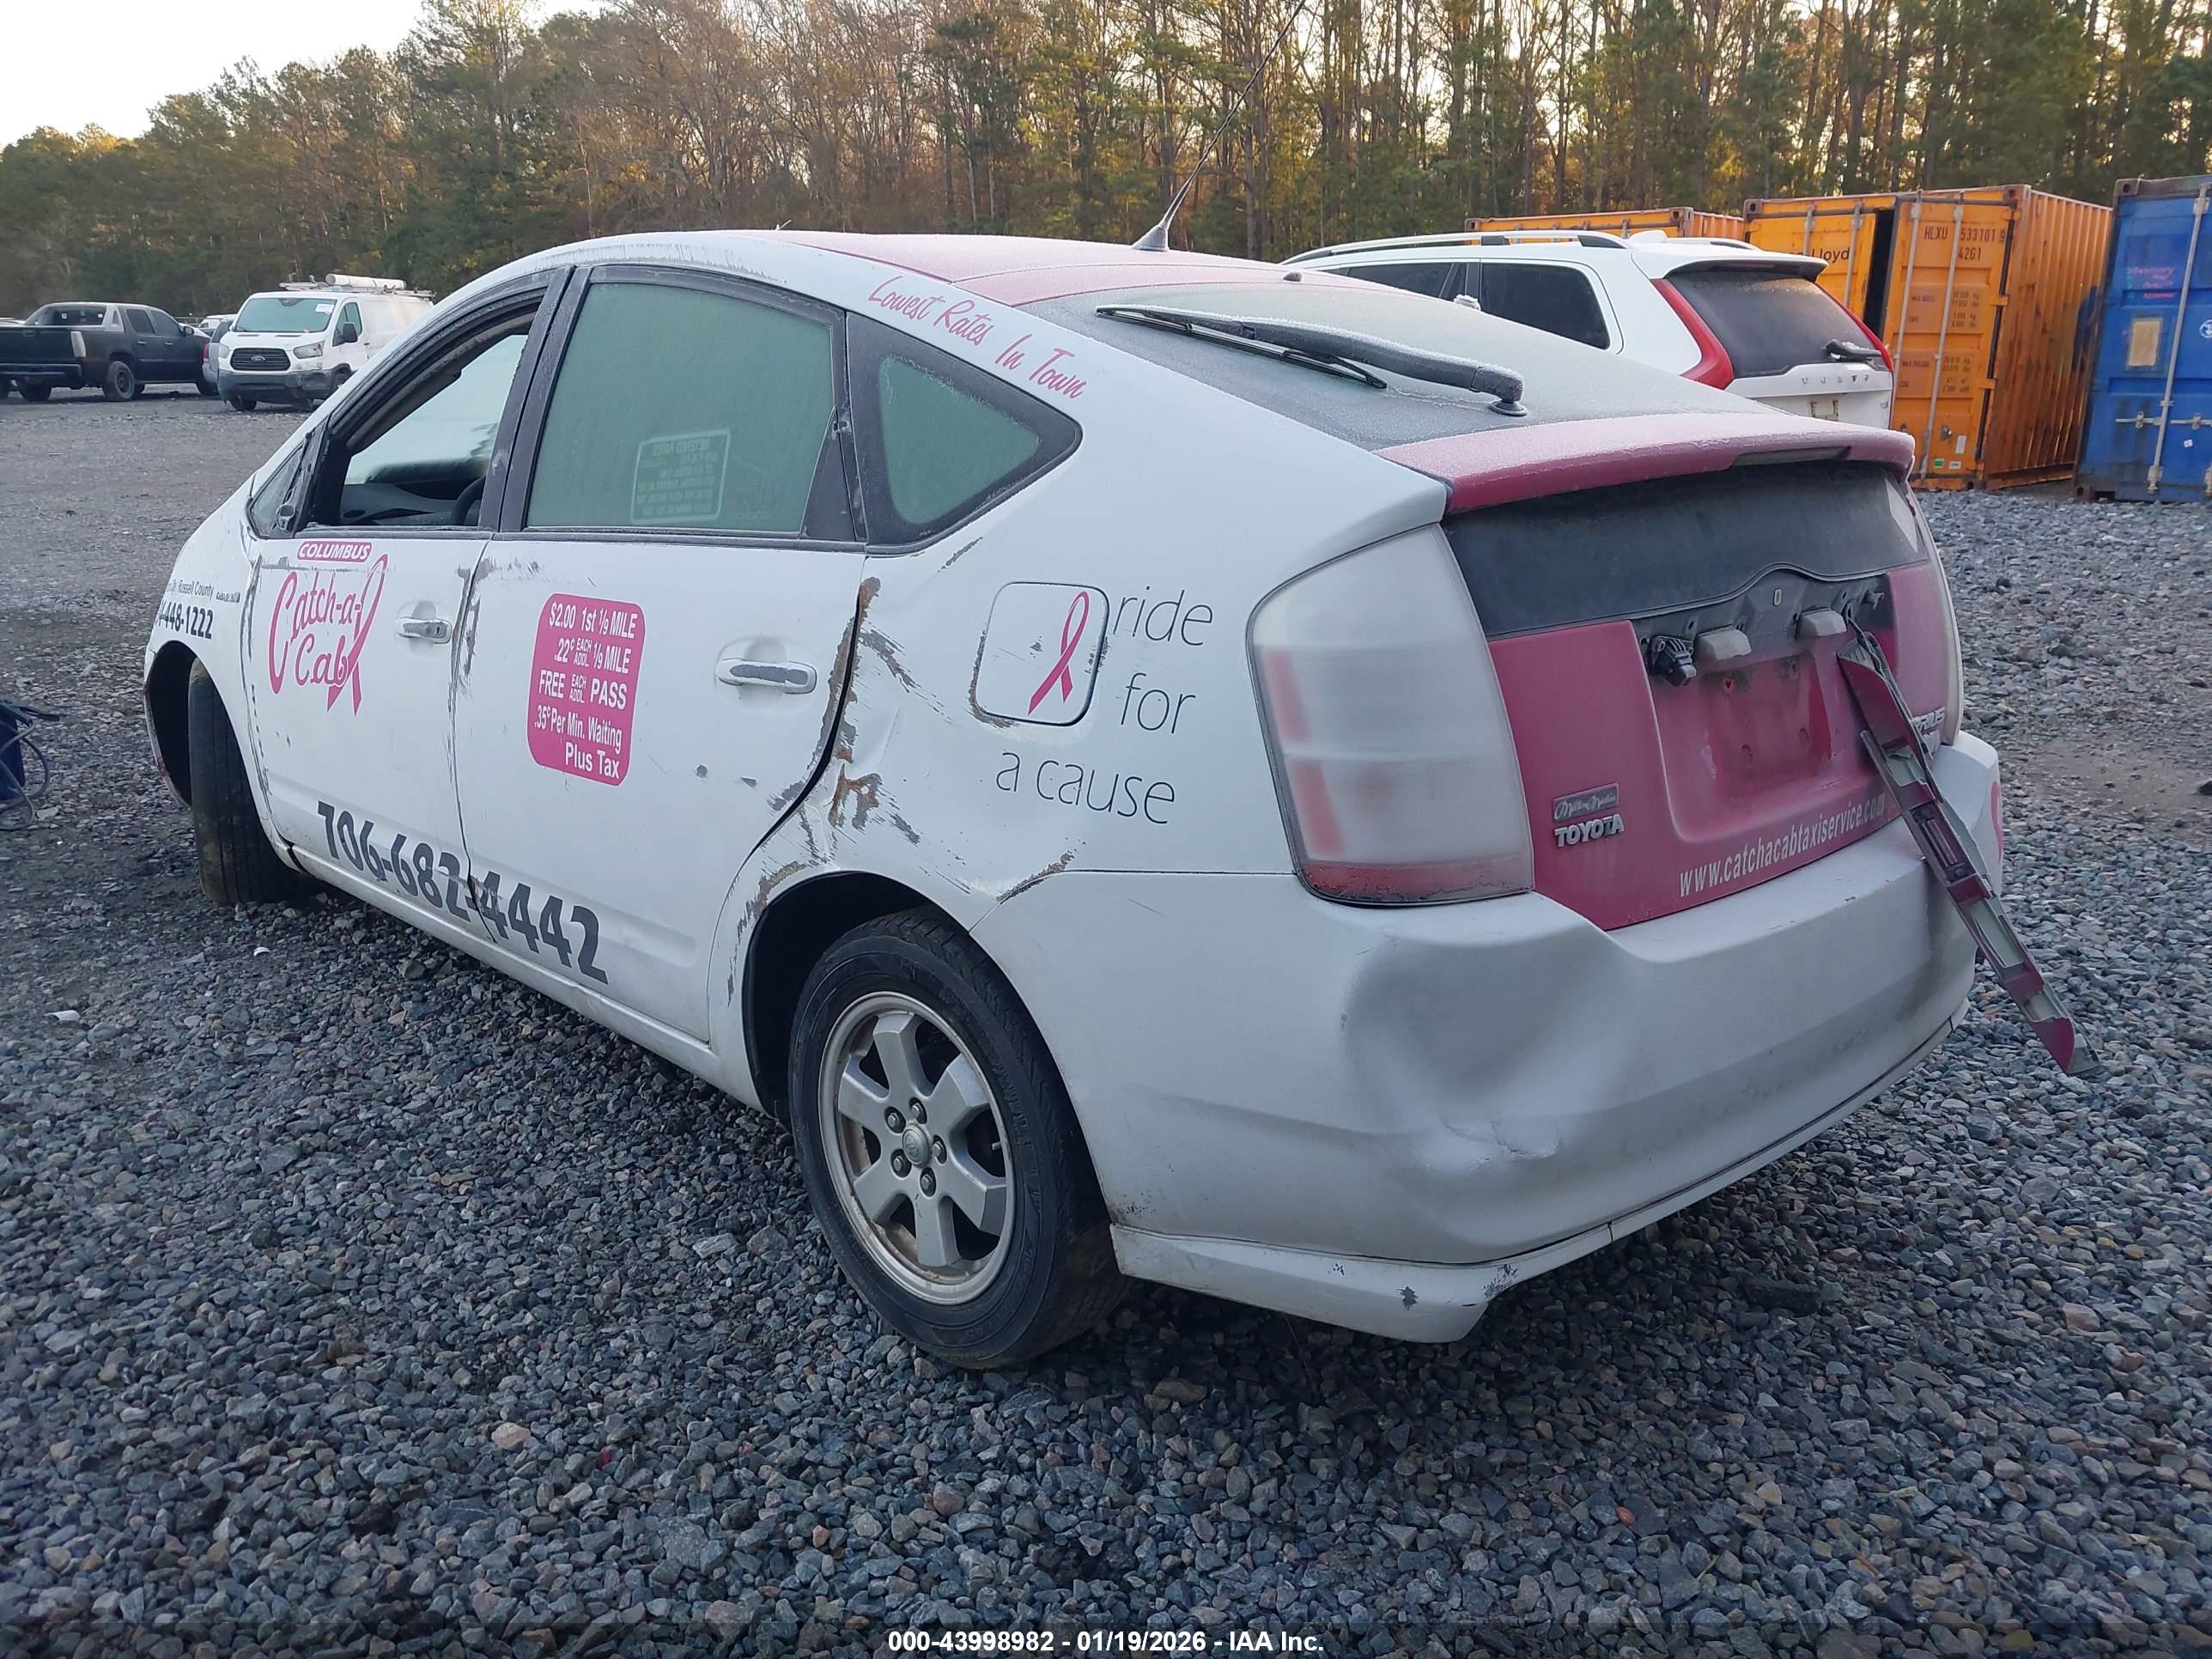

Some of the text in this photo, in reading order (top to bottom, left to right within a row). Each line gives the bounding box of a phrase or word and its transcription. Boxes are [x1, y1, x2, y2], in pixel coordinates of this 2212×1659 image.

[1923, 226, 1948, 240] HLXU
[868, 276, 1087, 399] Lowest Rates In Town
[299, 543, 371, 560] COLUMBUS
[194, 581, 215, 601] County
[549, 601, 577, 629] $2.00
[581, 606, 597, 633] 1st
[610, 611, 638, 639] MILE
[1113, 586, 1213, 646] ride
[295, 634, 349, 687] Cab
[575, 637, 592, 653] EACH
[603, 645, 632, 674] MILE
[538, 669, 587, 699] FREE EACH
[590, 678, 628, 710] PASS
[1120, 672, 1196, 734] for
[550, 708, 566, 734] Per
[567, 711, 586, 739] Min.
[587, 716, 623, 755] Waiting
[565, 741, 620, 780] Plus Tax
[996, 751, 1176, 824] a cause
[1553, 813, 1626, 848] TOYOTA
[1680, 792, 1887, 897] www.catchacabtaxiservice.com
[317, 800, 609, 985] 706-682-4442
